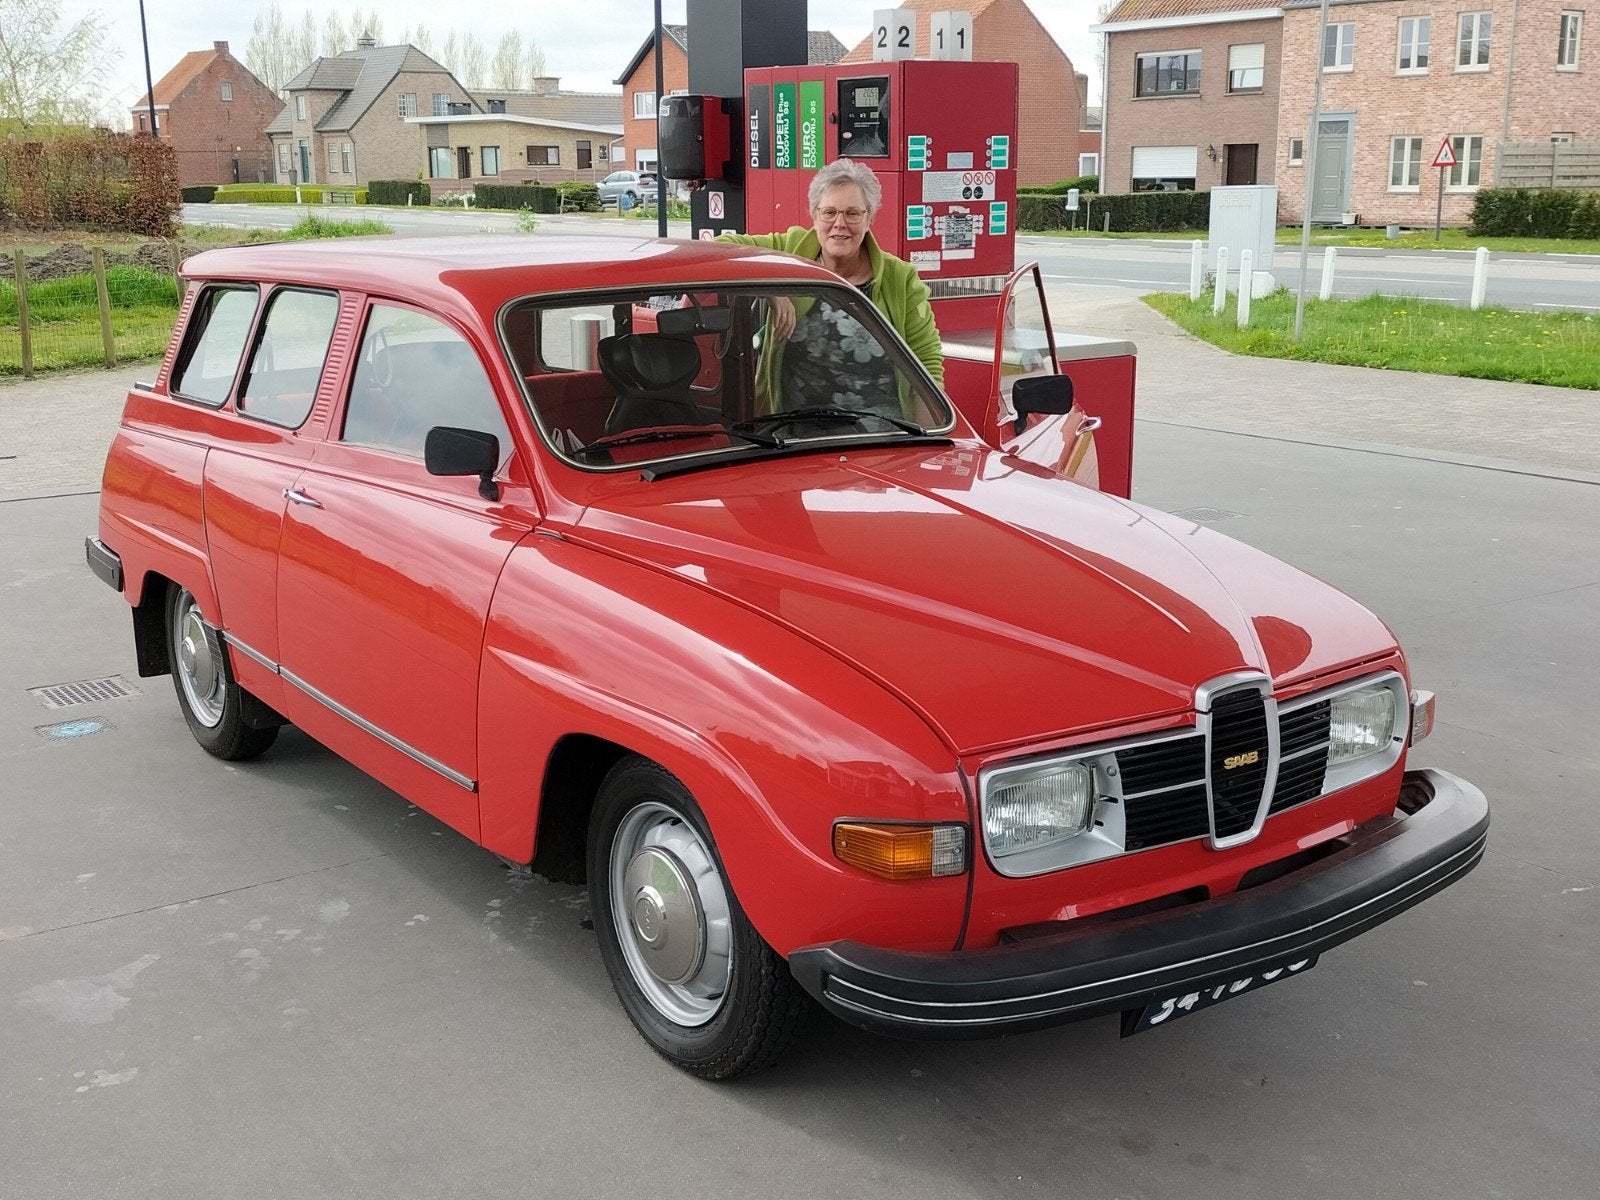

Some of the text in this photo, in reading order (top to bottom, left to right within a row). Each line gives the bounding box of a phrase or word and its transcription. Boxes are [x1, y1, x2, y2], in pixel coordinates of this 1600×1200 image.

[877, 26, 887, 48] 2
[898, 25, 910, 48] 2
[936, 27, 943, 49] 1
[957, 27, 965, 49] 1
[810, 100, 817, 114] 95
[750, 109, 759, 168] DIESEL
[802, 121, 811, 168] EURO
[1223, 750, 1259, 770] SAAB
